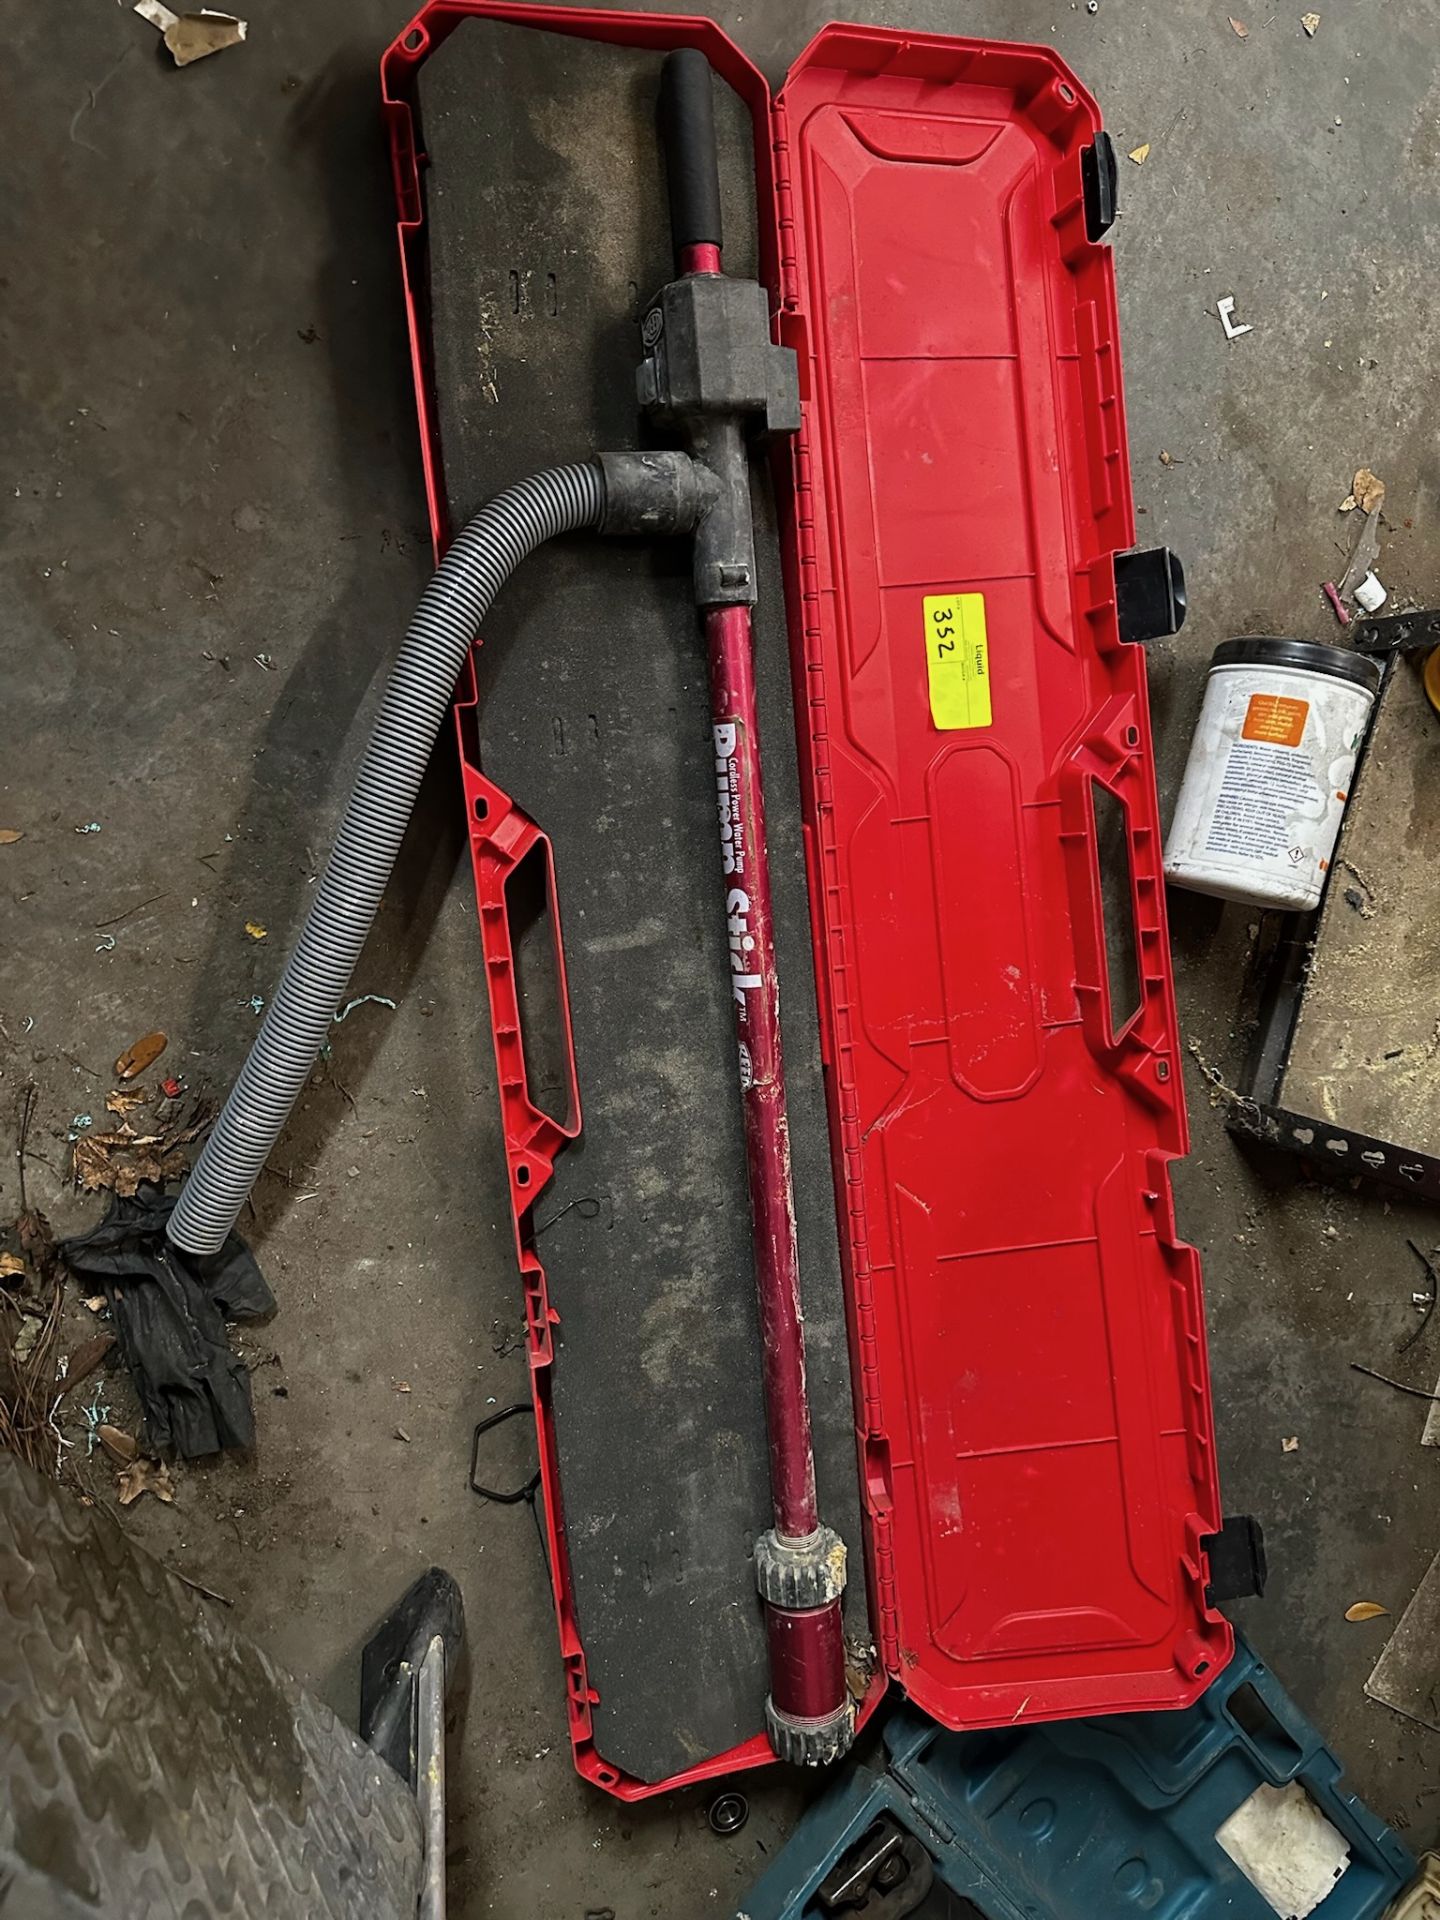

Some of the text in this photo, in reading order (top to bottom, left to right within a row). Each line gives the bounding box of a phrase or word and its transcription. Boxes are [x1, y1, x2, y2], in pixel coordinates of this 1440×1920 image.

[933, 608, 955, 659] 352
[975, 644, 985, 675] Liquid
[728, 757, 746, 874] Cordless Power Water Pump
